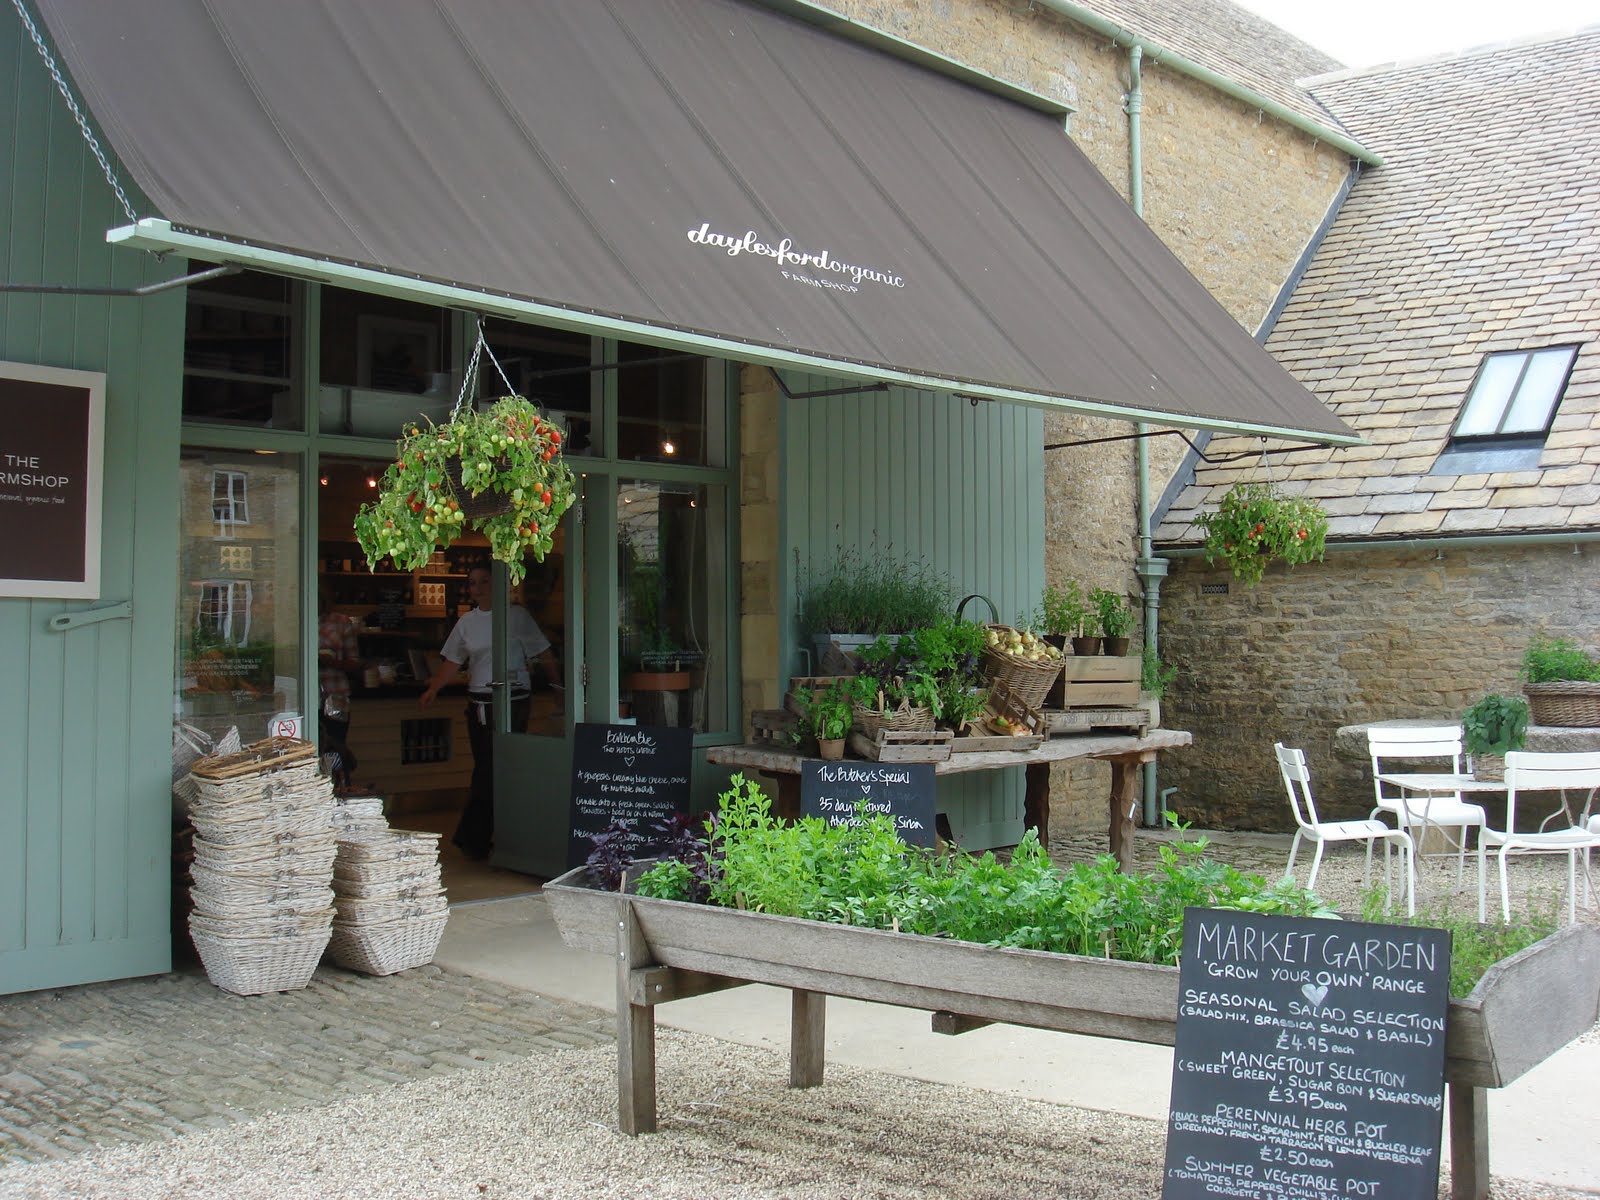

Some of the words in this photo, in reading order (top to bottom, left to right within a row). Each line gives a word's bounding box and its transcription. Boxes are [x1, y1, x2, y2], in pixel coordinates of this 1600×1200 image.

[781, 270, 858, 294] FARMSHOP
[4, 454, 40, 469] THE
[817, 765, 837, 782] The
[878, 768, 910, 786] Special
[820, 797, 833, 811] 35
[834, 799, 853, 818] day
[1197, 922, 1317, 963] MARKET
[1322, 935, 1435, 971] GARDEN
[1271, 967, 1311, 983] YOUR
[1372, 975, 1426, 994] RANGE
[1185, 988, 1278, 1012] SEASONAL
[1288, 1001, 1346, 1021] SALAD
[1353, 1009, 1445, 1031] SELECTION
[1254, 1014, 1316, 1031] BRASSICA
[1320, 1023, 1359, 1039] SALAD
[1276, 1028, 1329, 1053] £4.95
[1331, 1044, 1355, 1055] each
[1221, 1050, 1325, 1077] MANGETOUT
[1328, 1062, 1405, 1088] SELECTION
[1268, 1085, 1324, 1109] £3.95
[1323, 1099, 1348, 1112] each
[1288, 1075, 1333, 1092] SUGAR
[1336, 1082, 1363, 1096] BON
[1215, 1103, 1300, 1129] PERENNIAL
[1305, 1117, 1347, 1136] HERB
[1354, 1121, 1388, 1140] POT
[1229, 1129, 1266, 1142] FRENCH
[1267, 1135, 1324, 1152] TARRAGON
[1335, 1145, 1371, 1158] LEMON
[1371, 1150, 1424, 1166] VERBENA
[1259, 1144, 1308, 1166] £2.50
[1309, 1156, 1335, 1169] each
[1318, 1134, 1355, 1147] FRENCH
[1364, 1138, 1408, 1155] BUCKLER
[1410, 1145, 1433, 1158] LEAF
[1185, 1156, 1255, 1179] SUMMER
[1263, 1168, 1339, 1192] VEGETABLE
[1346, 1178, 1381, 1196] POT
[1206, 1184, 1261, 1200] COURGETTE
